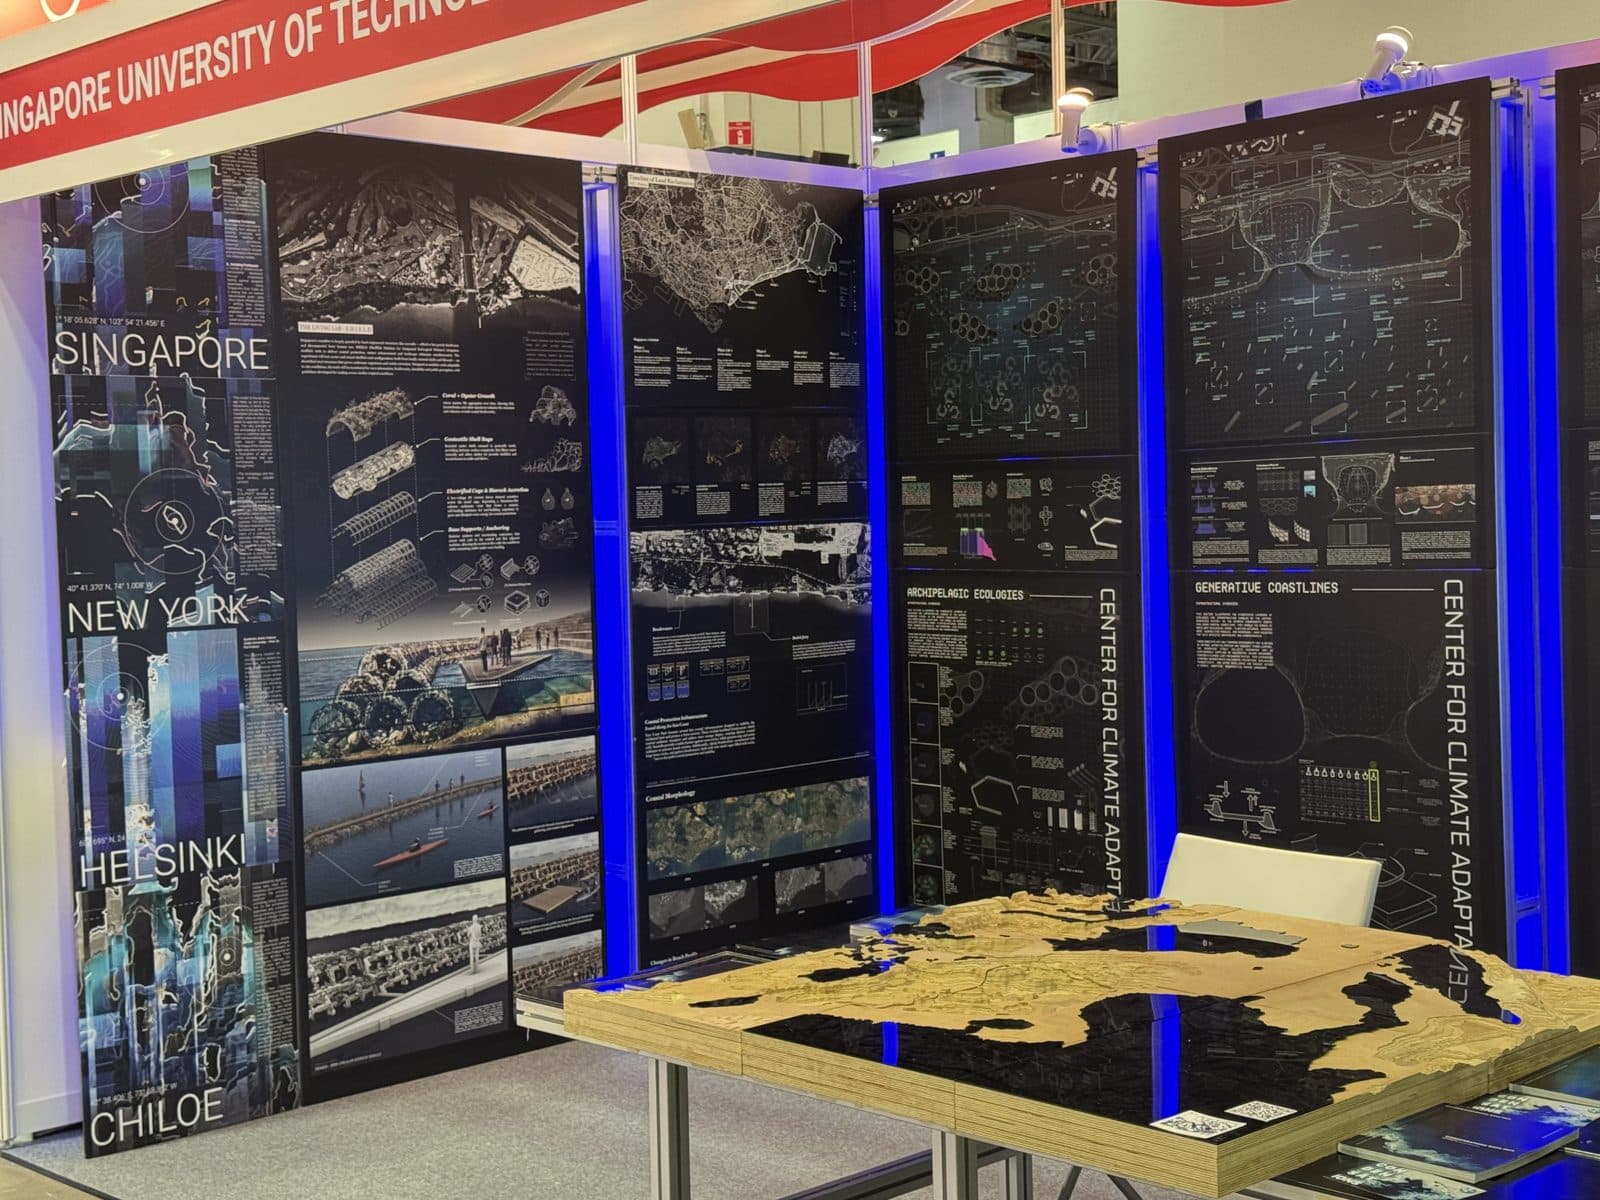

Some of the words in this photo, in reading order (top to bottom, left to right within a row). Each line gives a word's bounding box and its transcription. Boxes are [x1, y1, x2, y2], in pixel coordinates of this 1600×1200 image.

[118, 20, 276, 105] UNIVERSITY
[284, 6, 323, 58] OF
[55, 331, 270, 370] SINGAPORE
[68, 598, 150, 633] NEW
[158, 593, 250, 626] YORK
[907, 587, 969, 599] ARCHIPELAGIC
[974, 589, 1024, 601] ECOLOGIES
[1195, 581, 1262, 594] GENERATIVE
[1268, 580, 1339, 595] COASTLINES
[1099, 588, 1116, 672] CENTER
[1443, 579, 1465, 677] CENTER
[1101, 679, 1117, 721] FOR
[1446, 684, 1468, 735] FOR
[1102, 728, 1121, 818] CLIMATE
[1448, 741, 1471, 847] CLIMATE
[80, 833, 246, 888] HELSINKI
[91, 1086, 224, 1147] CHILOE
